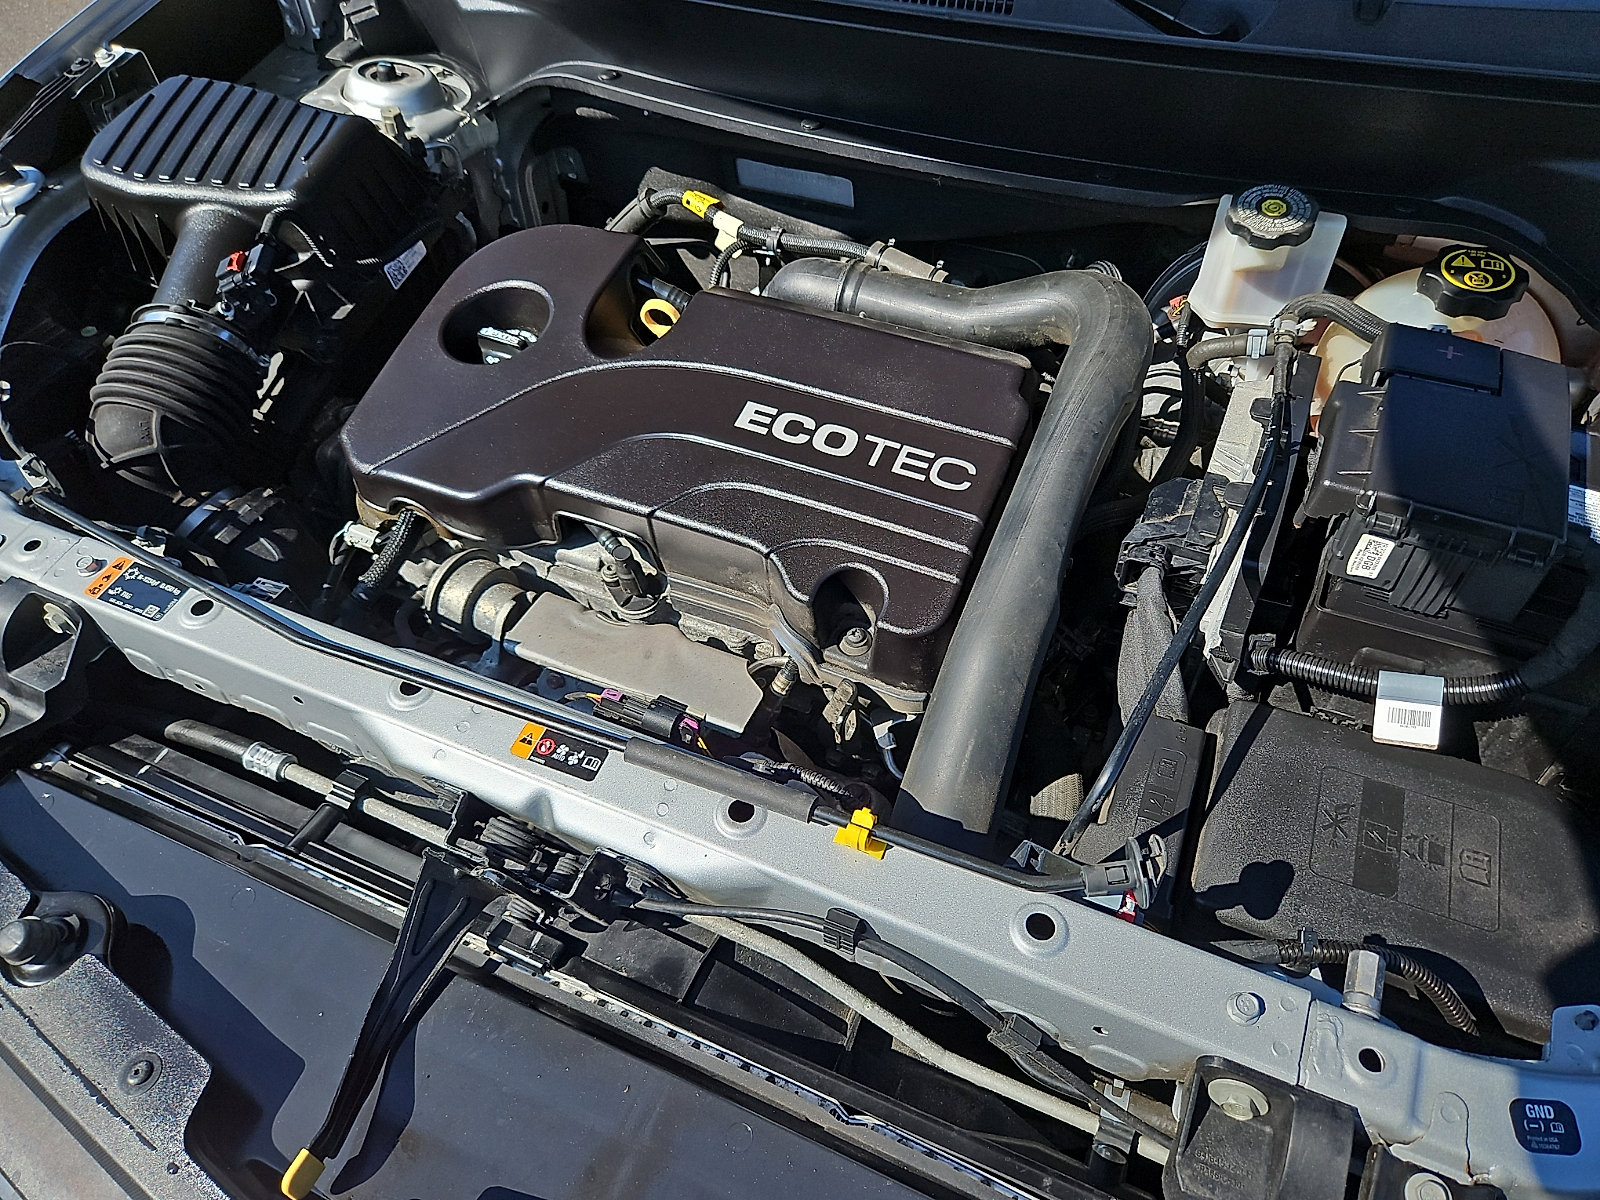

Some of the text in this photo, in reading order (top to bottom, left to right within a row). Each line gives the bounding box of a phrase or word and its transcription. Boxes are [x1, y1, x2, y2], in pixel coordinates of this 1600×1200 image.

[734, 400, 977, 491] ECOTEC
[551, 753, 566, 762] AUTO
[1525, 1104, 1554, 1119] GND
